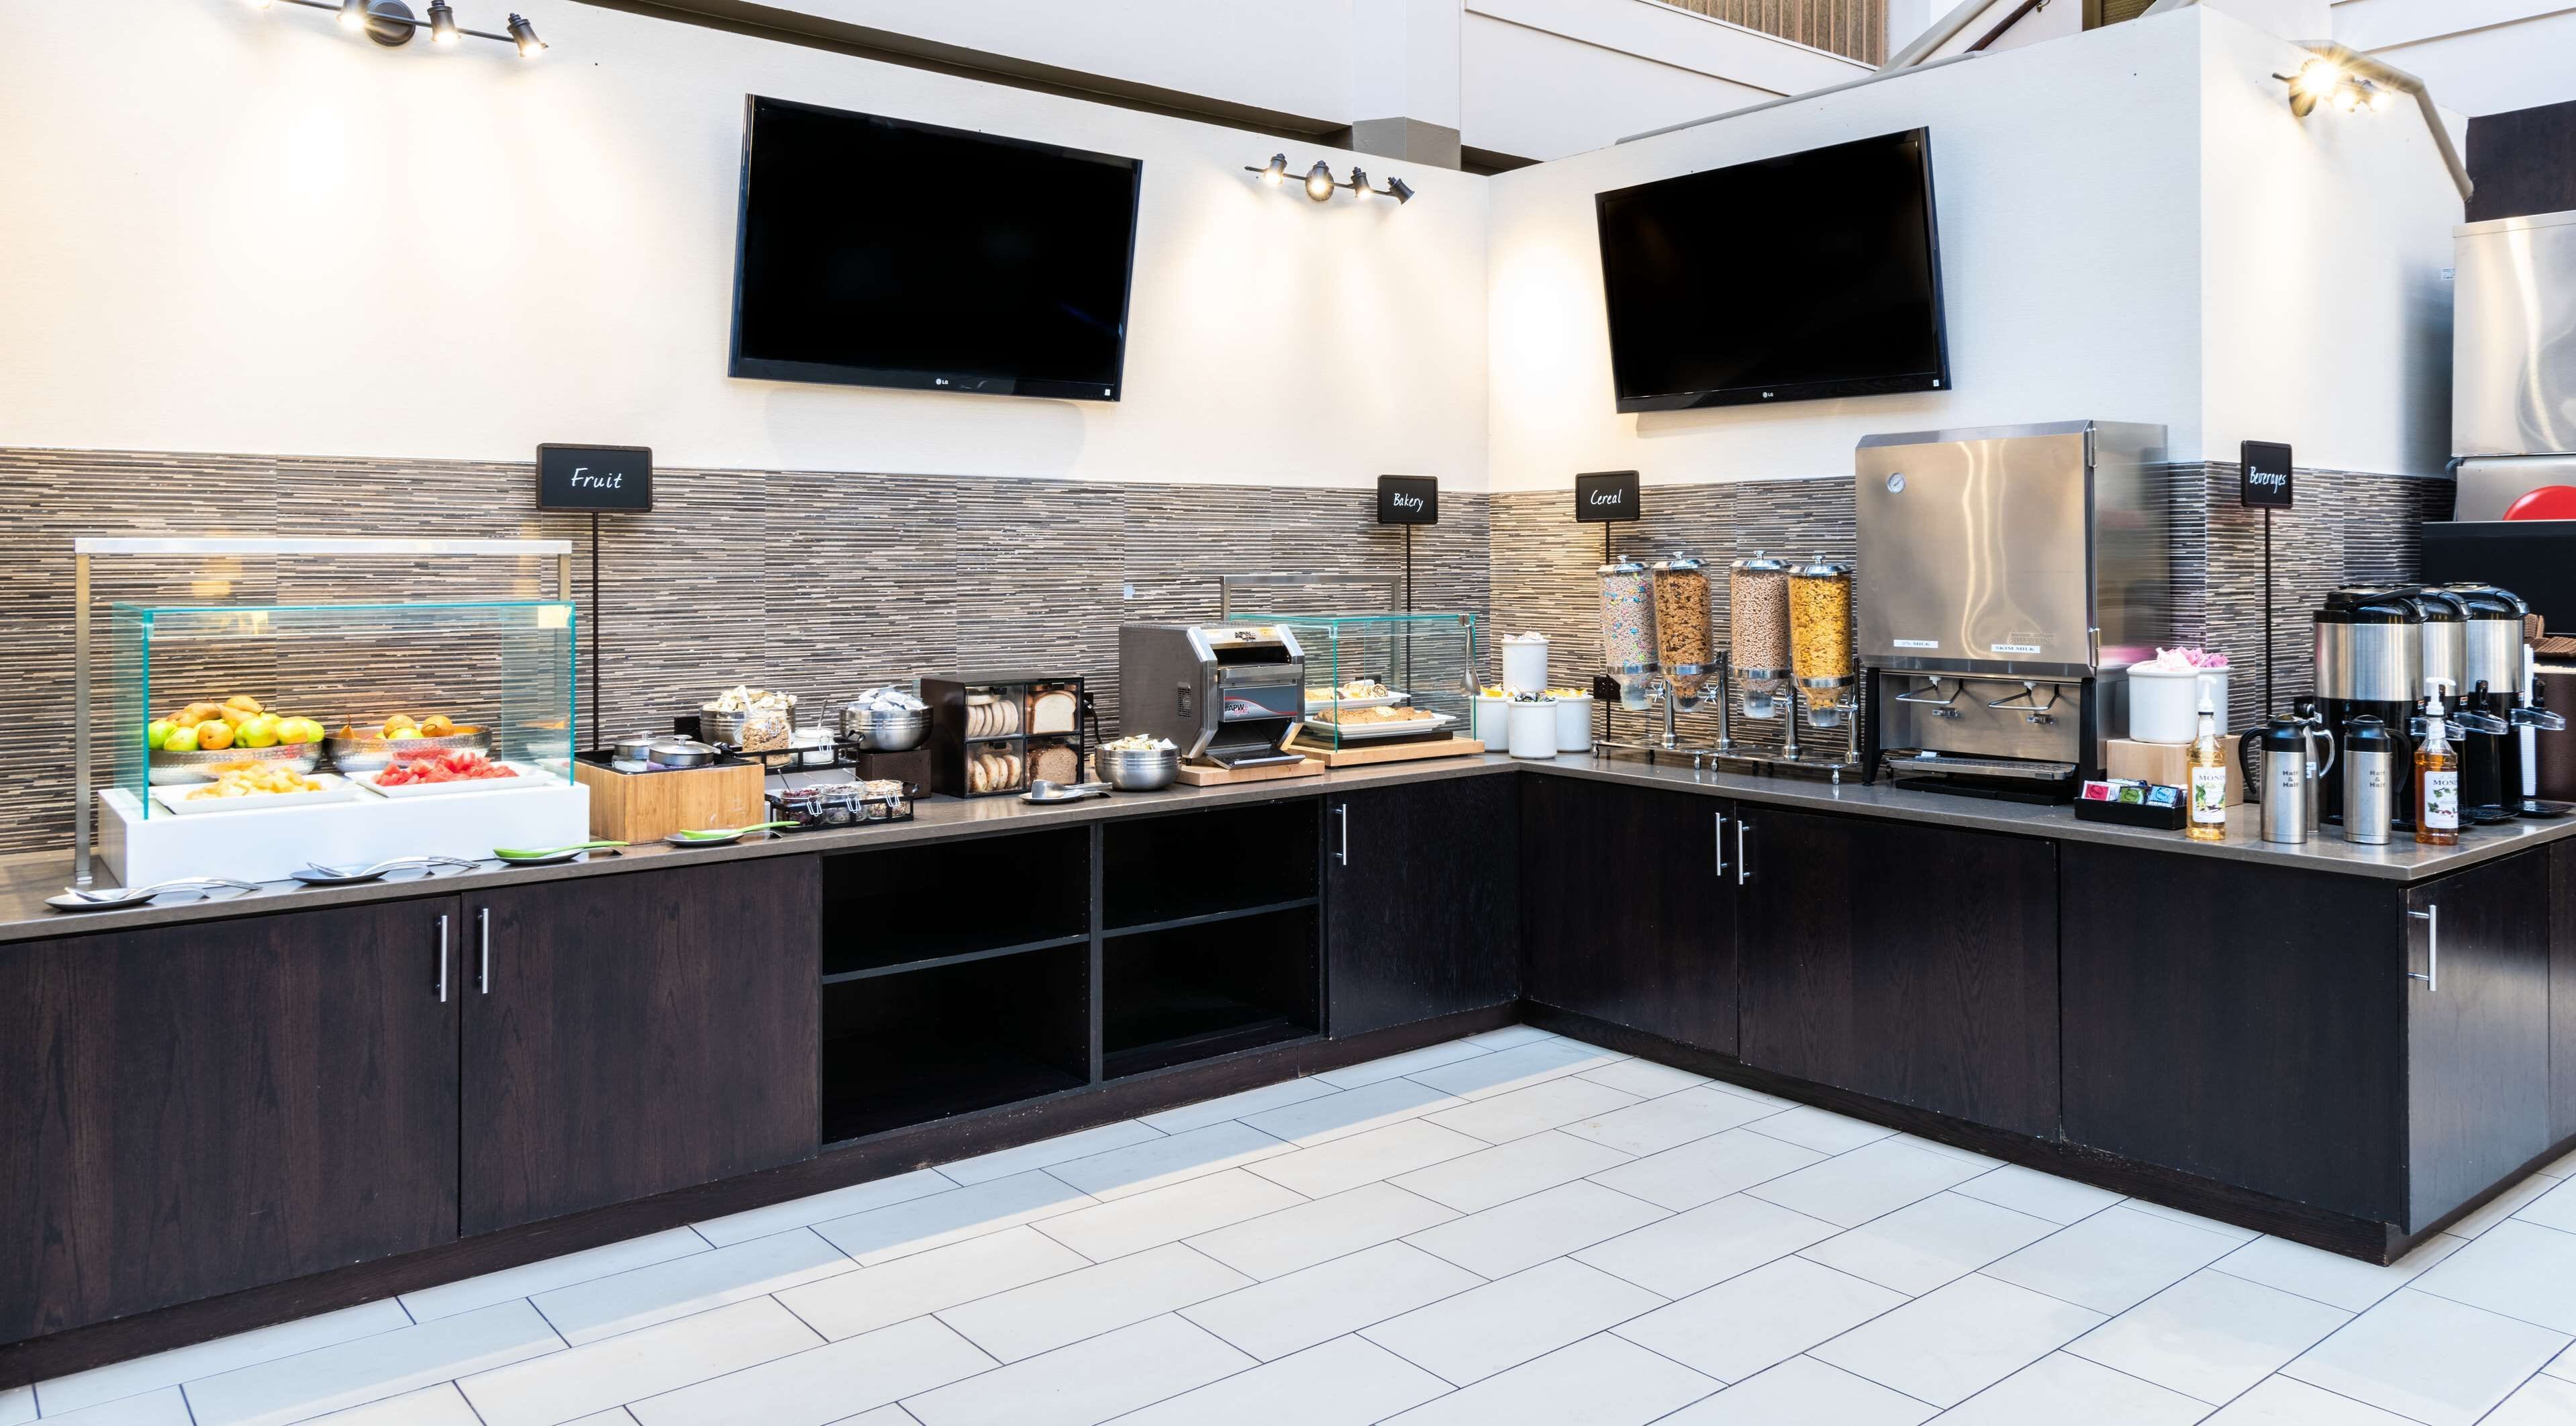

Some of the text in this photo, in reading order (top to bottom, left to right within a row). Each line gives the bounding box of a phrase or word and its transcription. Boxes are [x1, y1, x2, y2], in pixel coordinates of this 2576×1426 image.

[571, 467, 623, 489] Fruit
[2250, 466, 2287, 494] Beverages
[1393, 493, 1424, 513] Bakery
[1590, 489, 1622, 505] Cereal
[1228, 704, 1244, 712] APW
